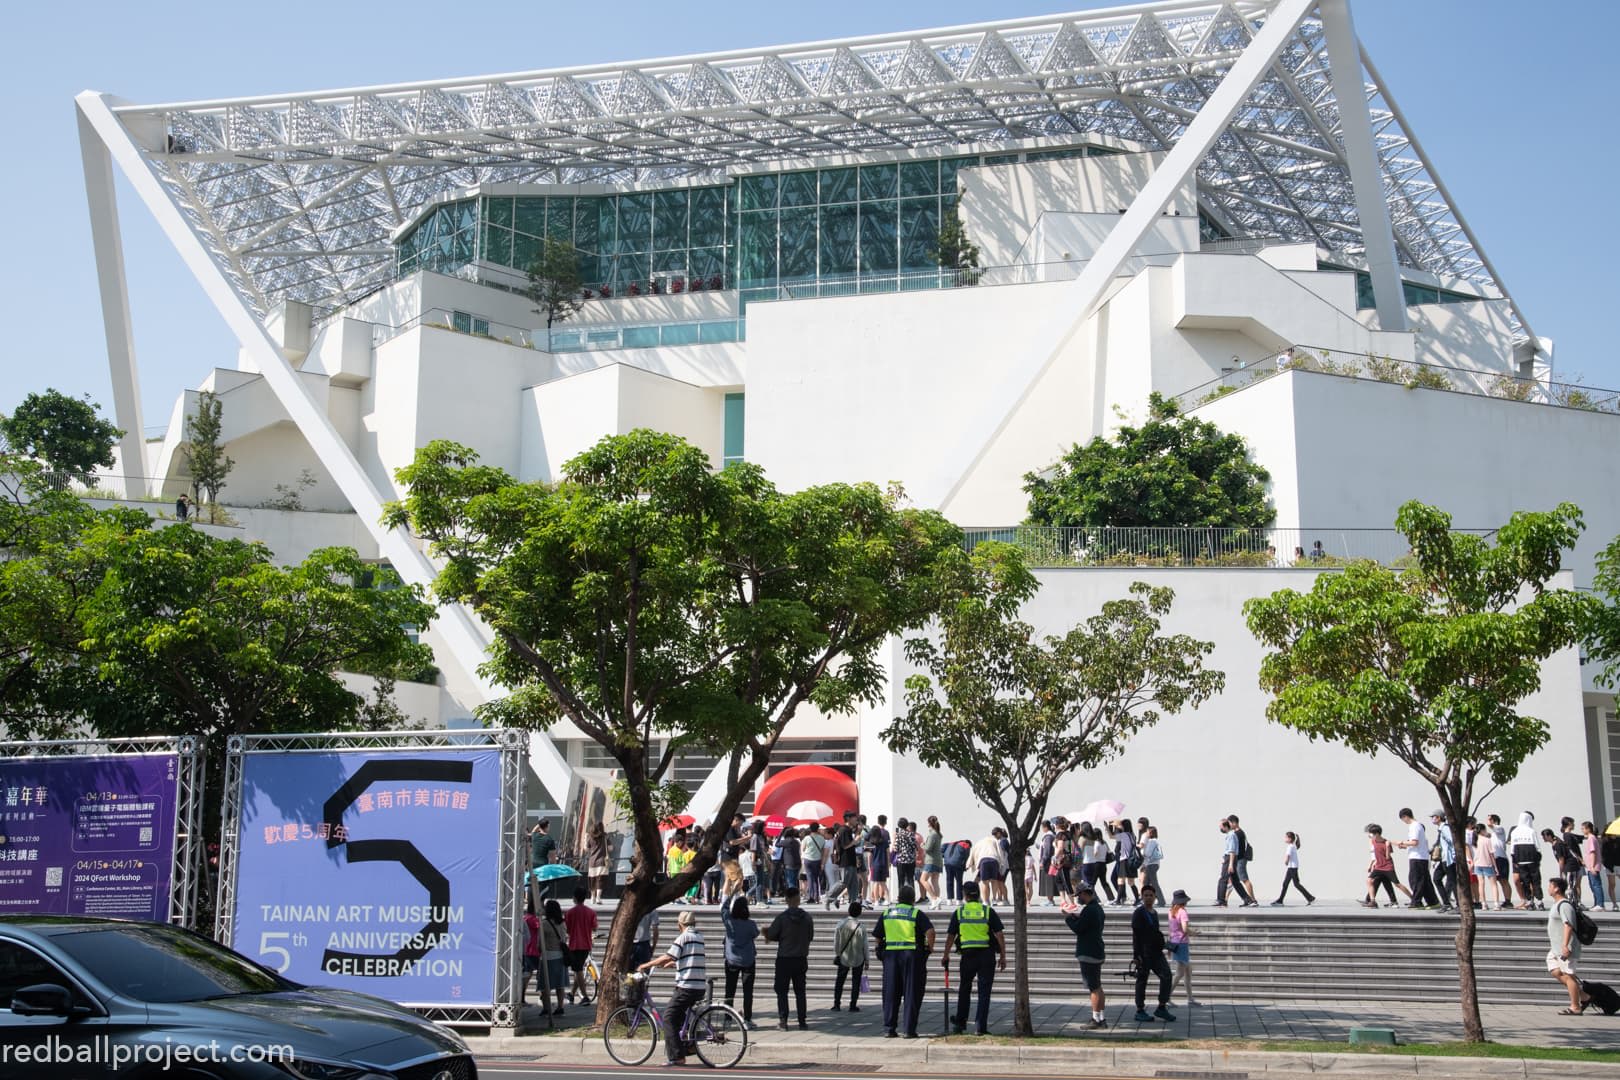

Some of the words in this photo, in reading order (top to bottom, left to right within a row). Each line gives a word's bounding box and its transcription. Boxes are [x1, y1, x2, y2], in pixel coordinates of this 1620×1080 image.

[0, 786, 49, 806] 嘉年華
[86, 792, 112, 801] 04/13
[358, 788, 470, 813] 臺南市美術館
[263, 822, 351, 844] 歡慶5周年
[91, 874, 108, 883] QFort
[109, 873, 141, 882] Workshop
[261, 905, 330, 923] TAINAN
[335, 905, 373, 923] ART
[379, 905, 464, 923] MUSEUM
[327, 932, 464, 950] ANNIVERSARY
[325, 958, 463, 977] CELEBRATION
